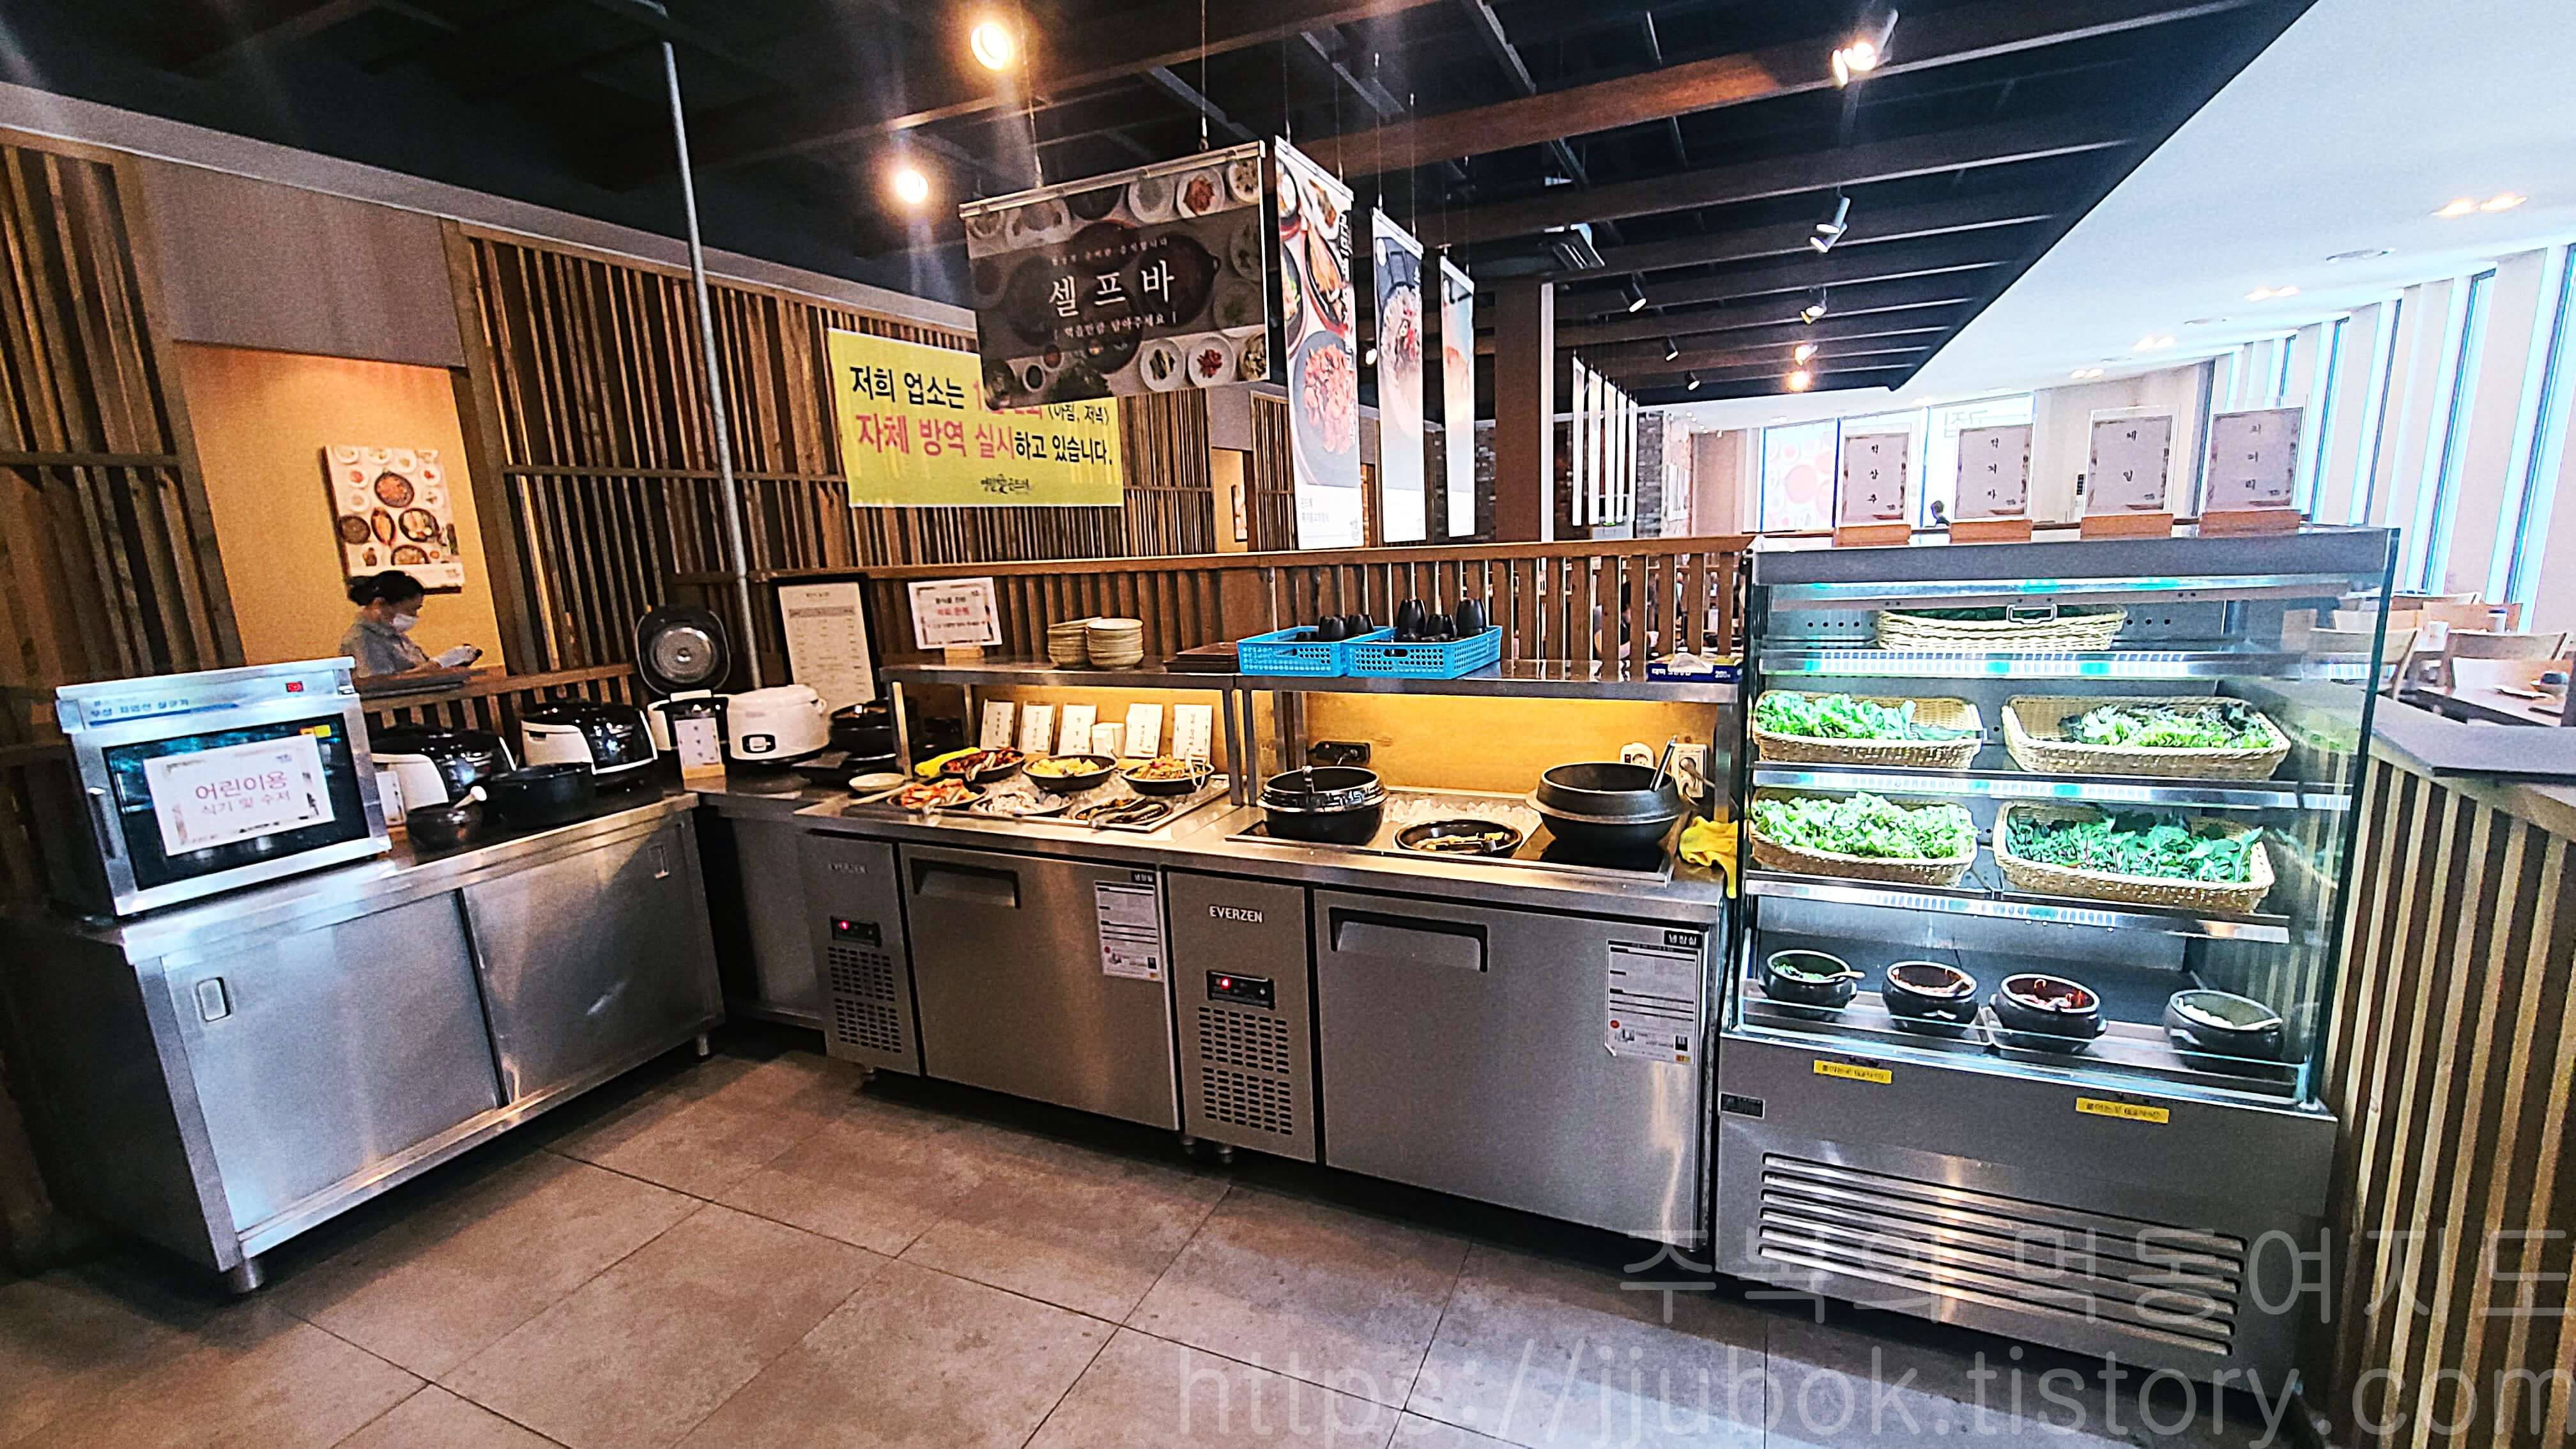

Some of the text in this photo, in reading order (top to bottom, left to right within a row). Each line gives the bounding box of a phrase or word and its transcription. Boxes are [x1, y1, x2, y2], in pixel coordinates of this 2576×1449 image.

[1048, 259, 1176, 318] 셀프바
[1110, 313, 1165, 332] 담아주세요
[850, 365, 896, 402] 저희
[904, 372, 965, 410] 업소는
[855, 413, 1113, 466] 자체 방역 실시하고 있습니다.
[194, 771, 288, 801] 어린이용
[201, 800, 233, 815] 식기
[261, 790, 291, 806] 수저
[1209, 905, 1264, 924] EVERZEN
